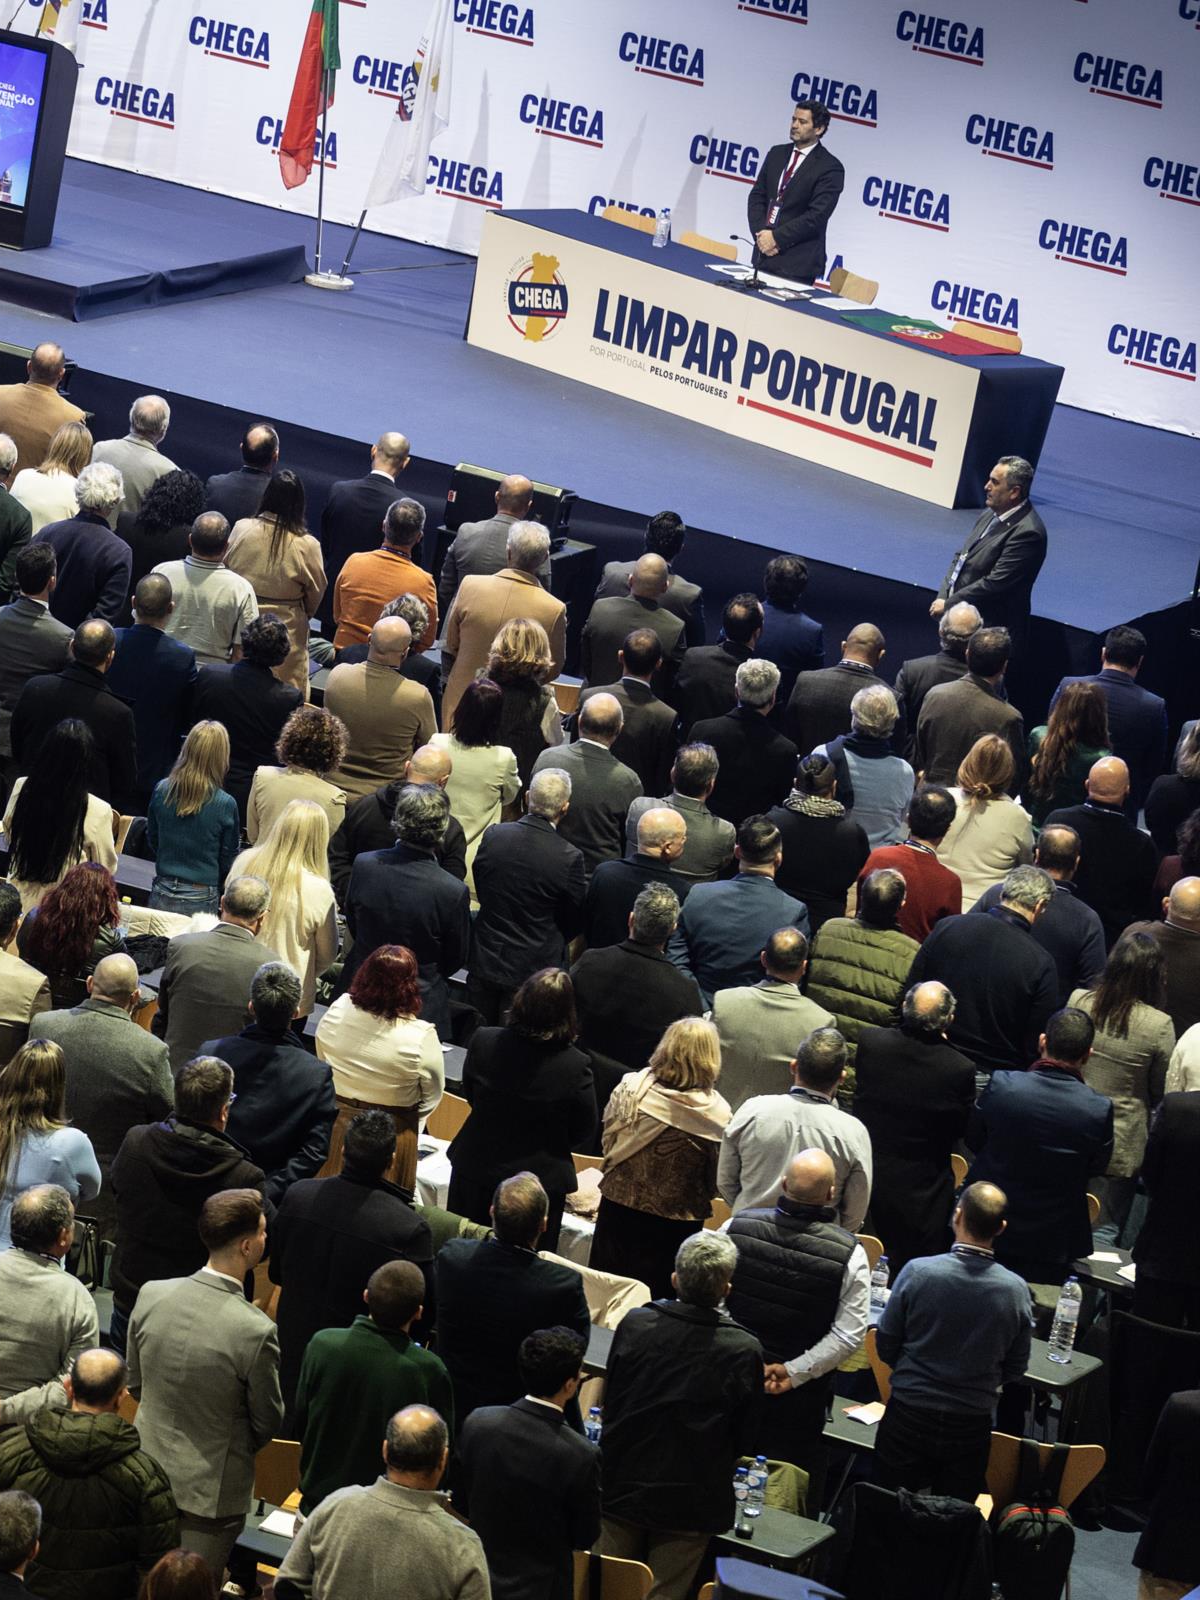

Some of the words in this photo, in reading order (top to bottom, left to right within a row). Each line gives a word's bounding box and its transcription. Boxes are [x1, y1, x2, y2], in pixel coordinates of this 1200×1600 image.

[188, 16, 270, 62] CHEGA
[454, 0, 534, 39] CHEGA
[895, 10, 984, 59] CHEGA
[618, 32, 704, 79] CHEGA
[1073, 52, 1163, 101] CHEGA
[94, 76, 175, 122] CHEGA
[519, 94, 604, 141] CHEGA
[689, 134, 760, 178] CHEG
[965, 114, 1054, 163] CHEGA
[425, 155, 503, 202] CHEGA
[862, 176, 950, 225] CHEGA
[1143, 156, 1200, 199] CHE
[1038, 218, 1128, 268] CHEGA
[514, 286, 563, 310] CHEGA
[930, 279, 1019, 329] CHEGA
[592, 287, 738, 385] LIMPAR
[740, 339, 938, 452] PORTUGAL
[1107, 323, 1197, 373] CHEGA
[589, 345, 606, 358] POR
[606, 351, 647, 372] PORTUGAL
[650, 365, 674, 381] PELOS
[674, 374, 729, 400] PORTUGUESES
